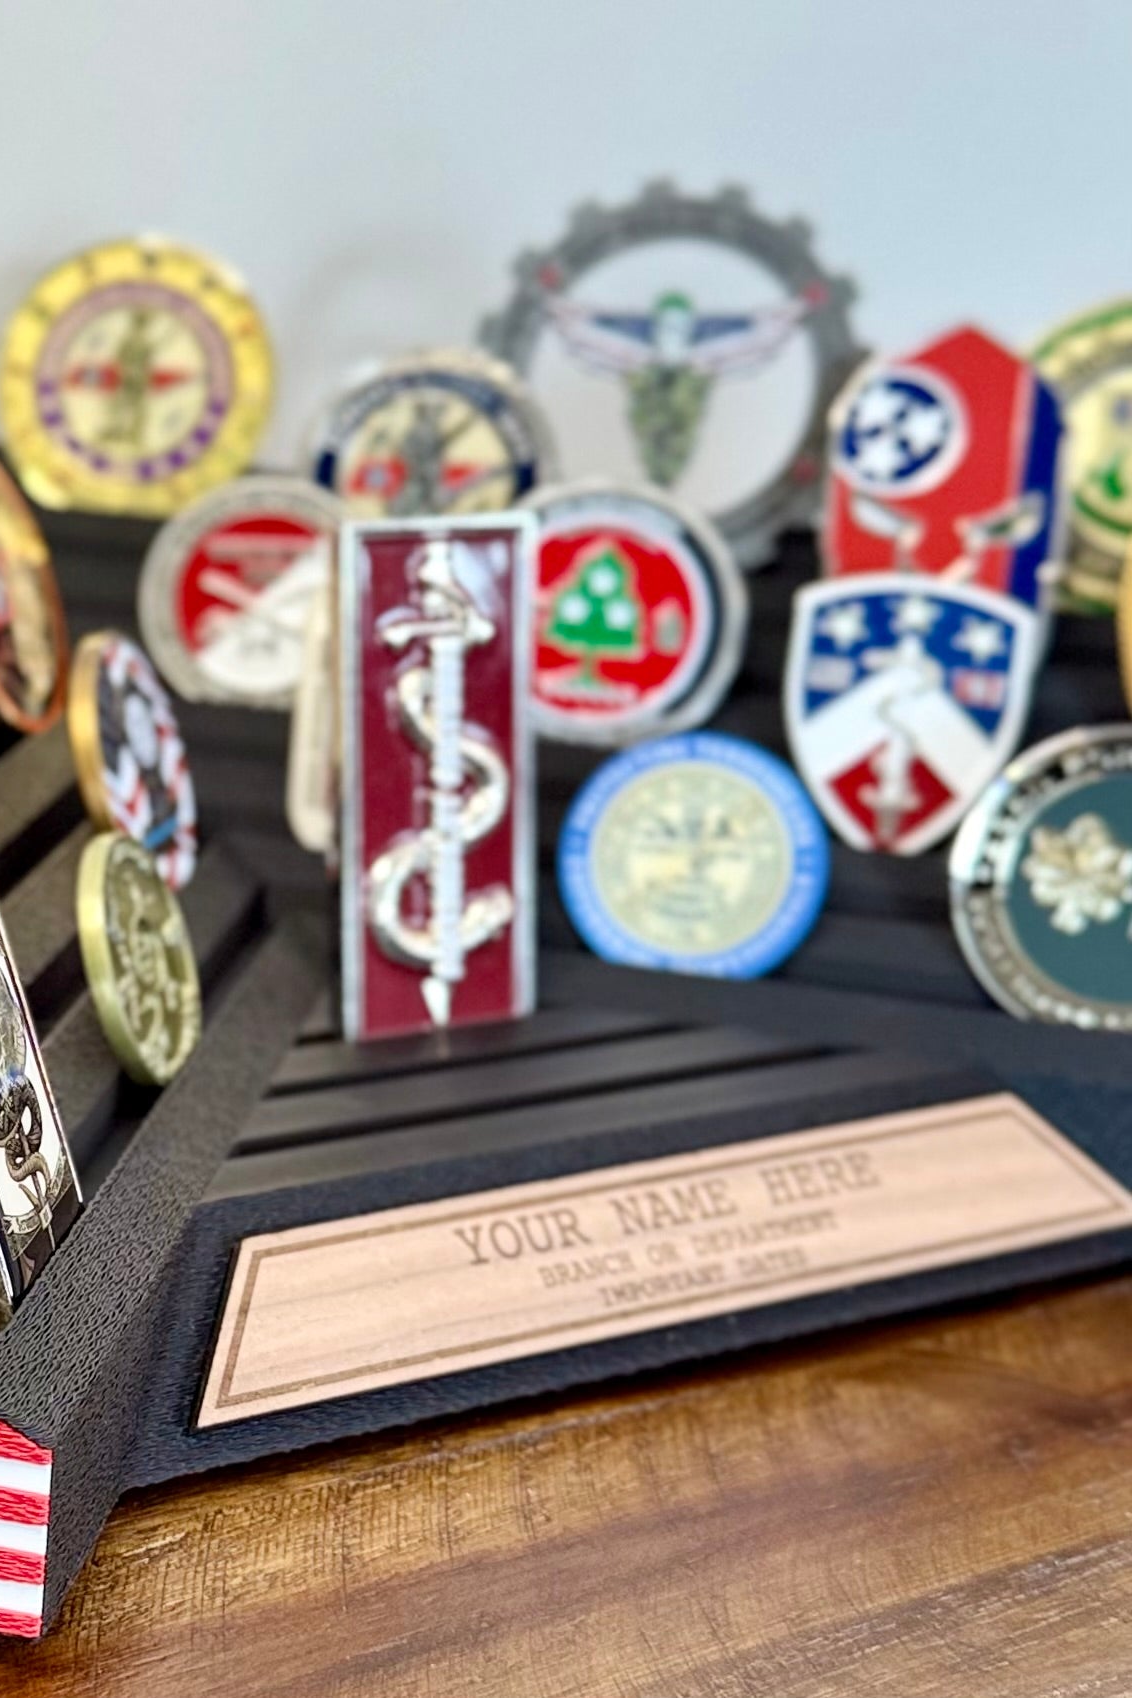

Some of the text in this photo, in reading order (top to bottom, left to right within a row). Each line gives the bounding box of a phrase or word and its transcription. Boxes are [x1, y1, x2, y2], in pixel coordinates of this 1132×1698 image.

[452, 1151, 881, 1266] YOUR NAME HERE
[537, 1207, 839, 1289] BRANCH OR DEPARTMENT
[599, 1246, 809, 1307] IMPORTANT DATES
